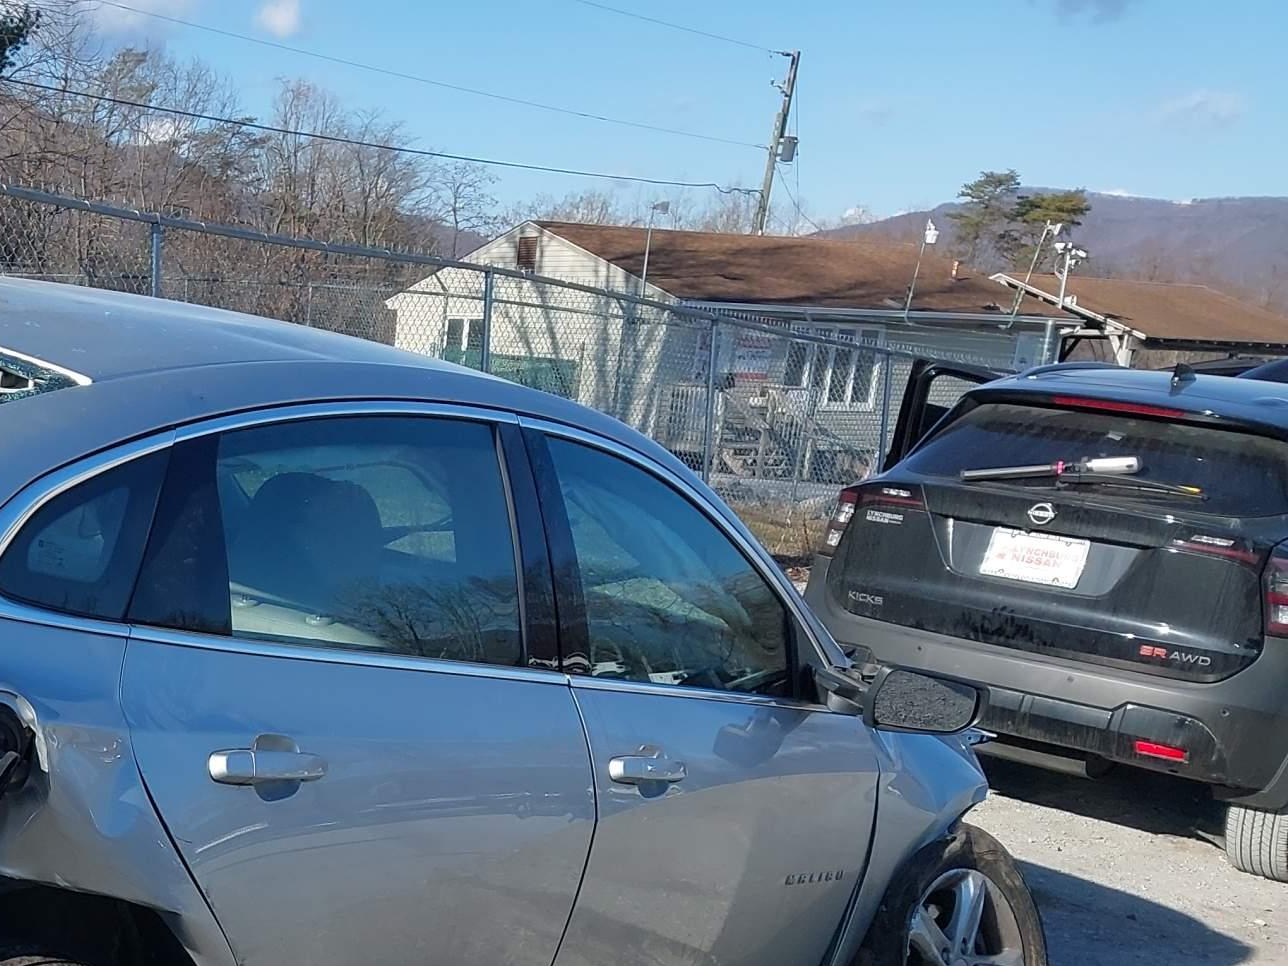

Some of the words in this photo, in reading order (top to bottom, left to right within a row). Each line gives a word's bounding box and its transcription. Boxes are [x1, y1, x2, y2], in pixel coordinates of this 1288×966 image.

[1009, 545, 1083, 562] LYNCHBURG
[1010, 554, 1063, 569] NISSAN
[848, 590, 883, 606] KICKS
[1169, 651, 1211, 666] AWD
